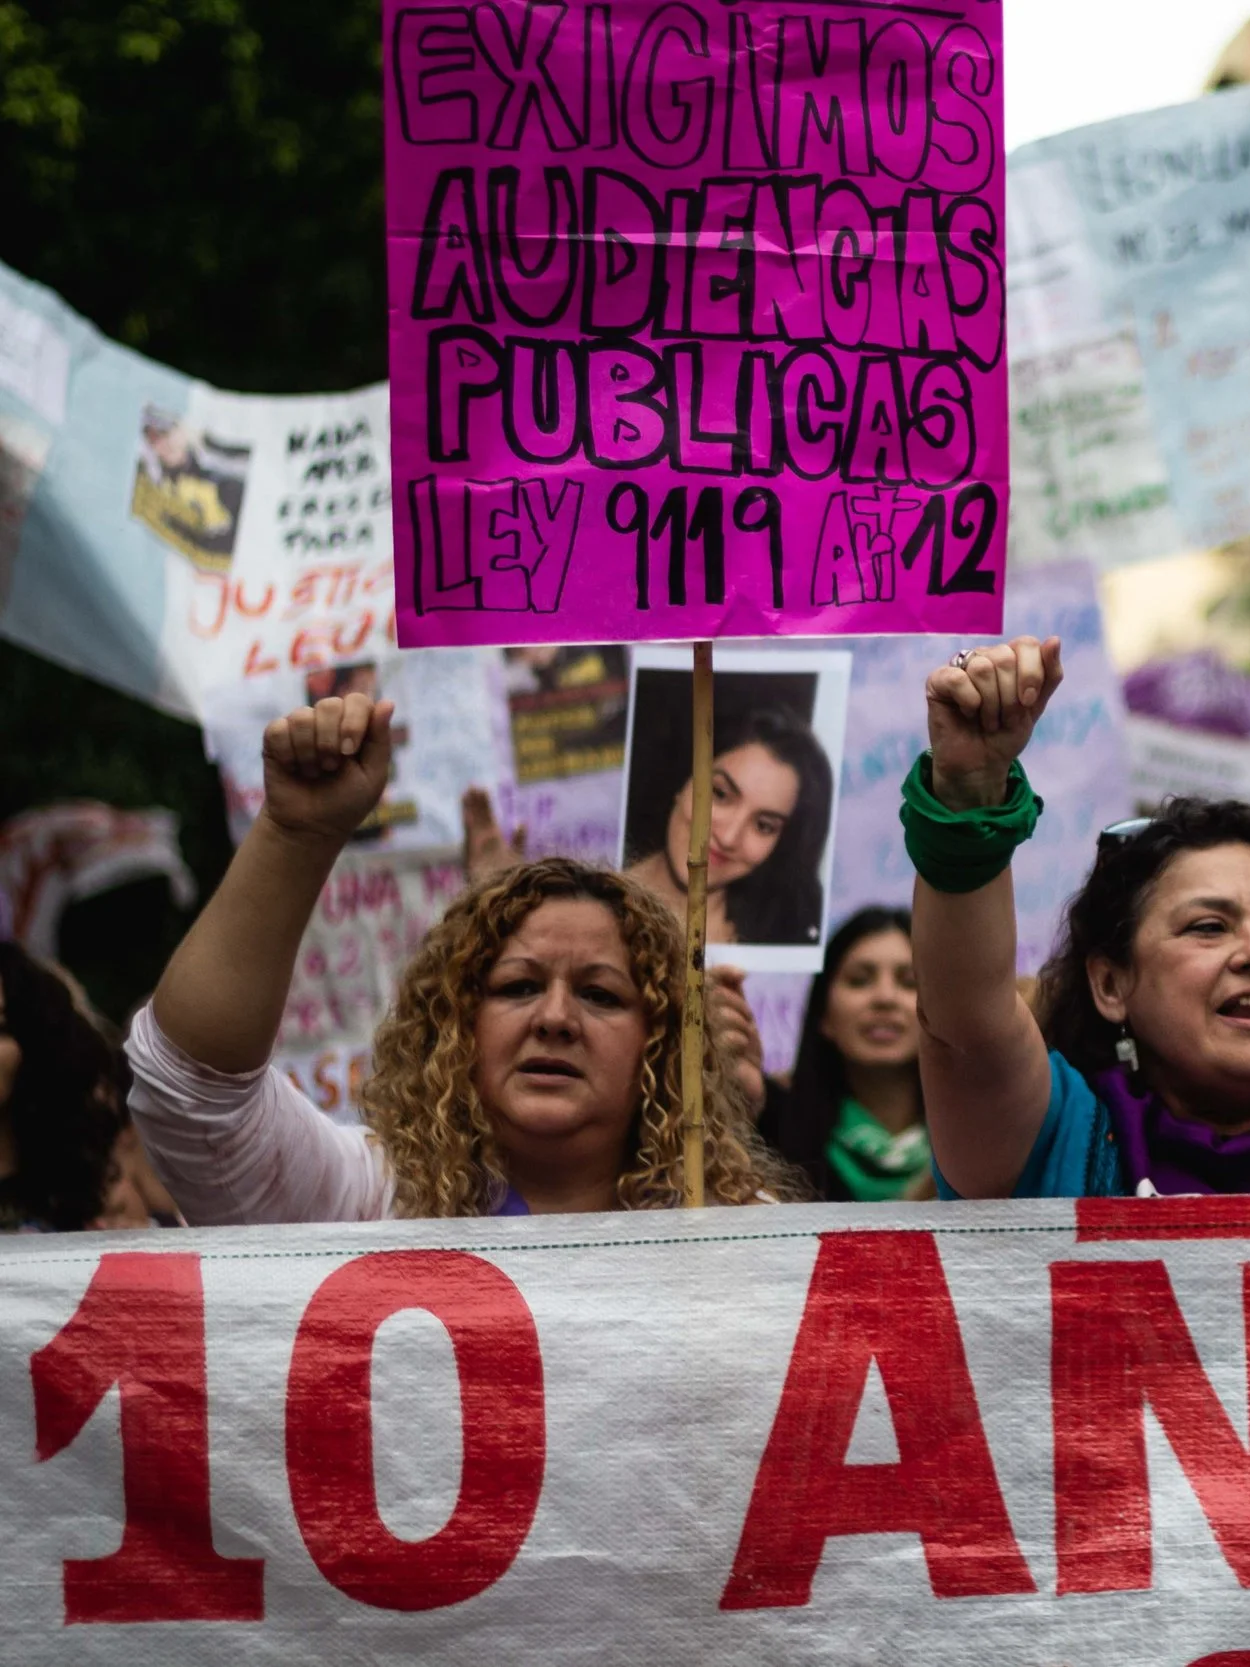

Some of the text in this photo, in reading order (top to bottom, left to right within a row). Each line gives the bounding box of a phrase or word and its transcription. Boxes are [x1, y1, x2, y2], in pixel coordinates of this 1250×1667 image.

[393, 1, 996, 195] EXIGIMOS
[411, 166, 1004, 371] AUDIENCIAS
[427, 325, 977, 491] PUBLICAS
[409, 473, 584, 616] LEY
[605, 481, 784, 611] 9119
[901, 482, 998, 596] 12
[30, 1247, 546, 1624] 10
